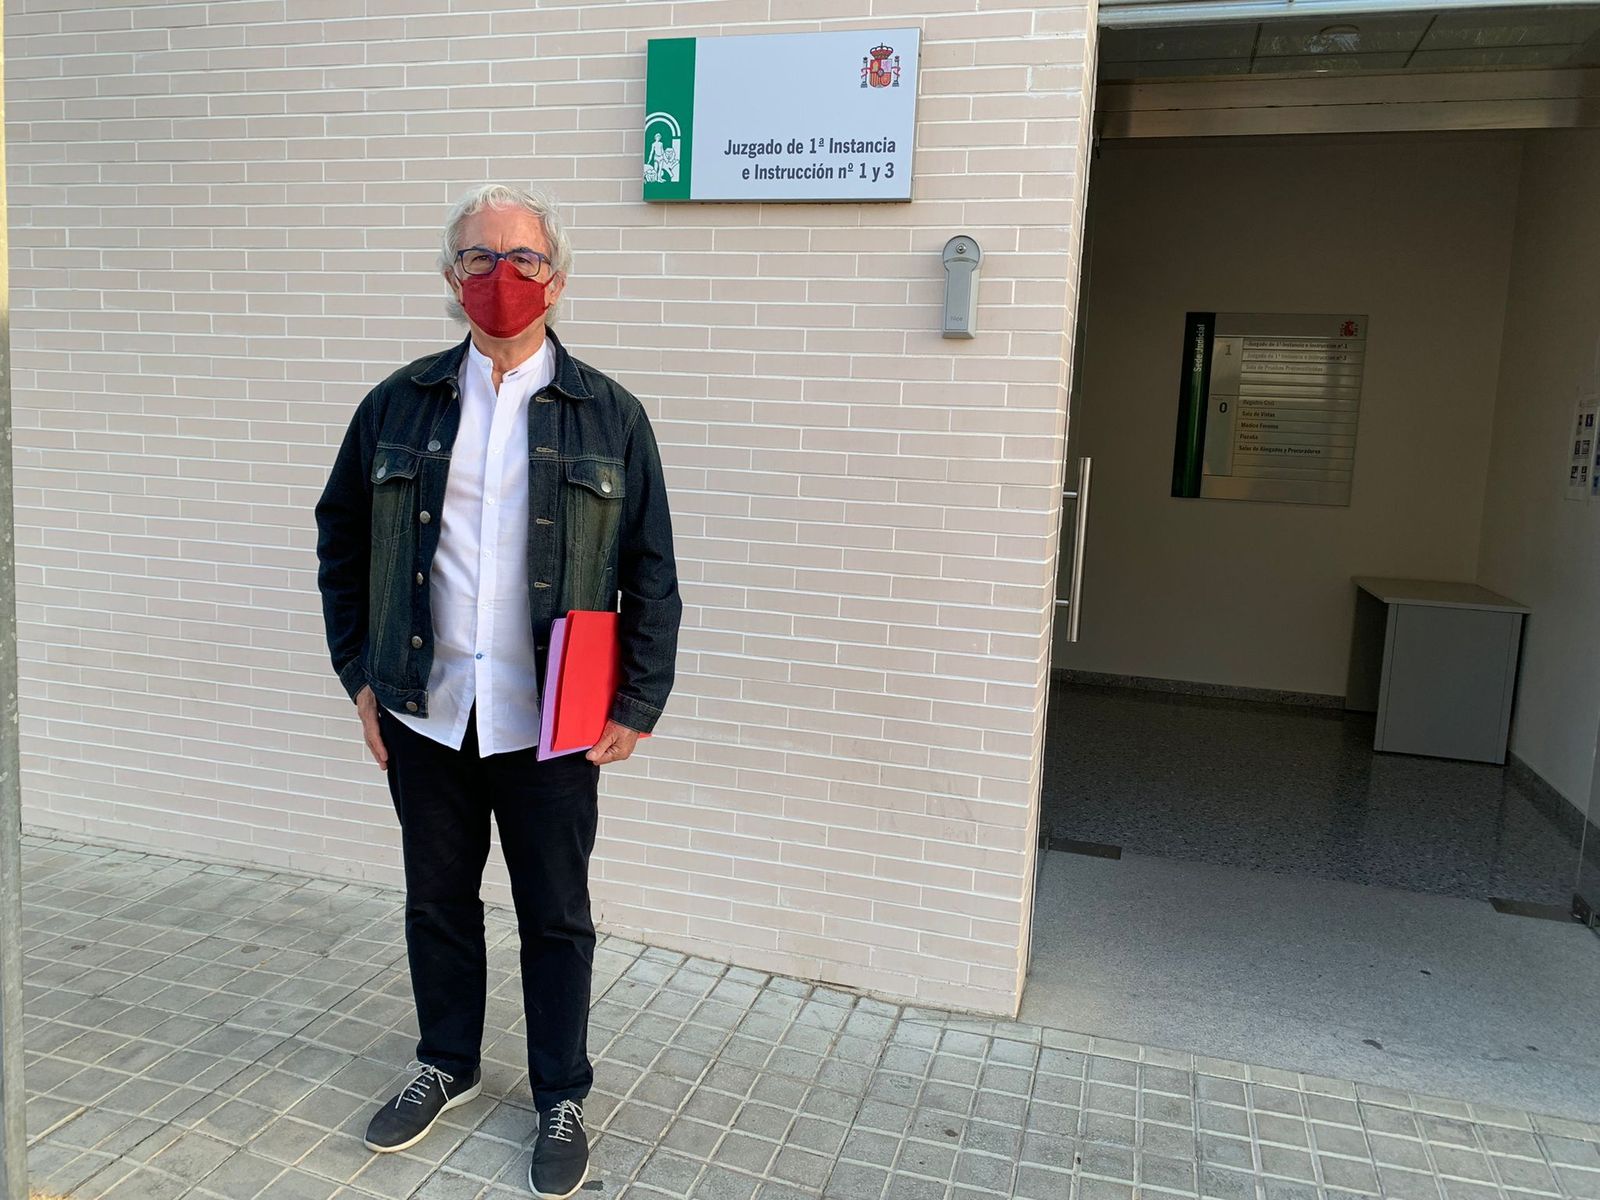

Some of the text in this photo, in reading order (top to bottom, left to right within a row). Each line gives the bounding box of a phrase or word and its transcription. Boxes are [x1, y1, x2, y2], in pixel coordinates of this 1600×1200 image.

[724, 137, 896, 158] Juzgado de 1ª Instancia
[742, 162, 895, 182] e Instrucción nº 1 y 3
[1193, 324, 1205, 372] Sede Judicial
[1225, 344, 1232, 356] 1
[1219, 402, 1228, 413] 0
